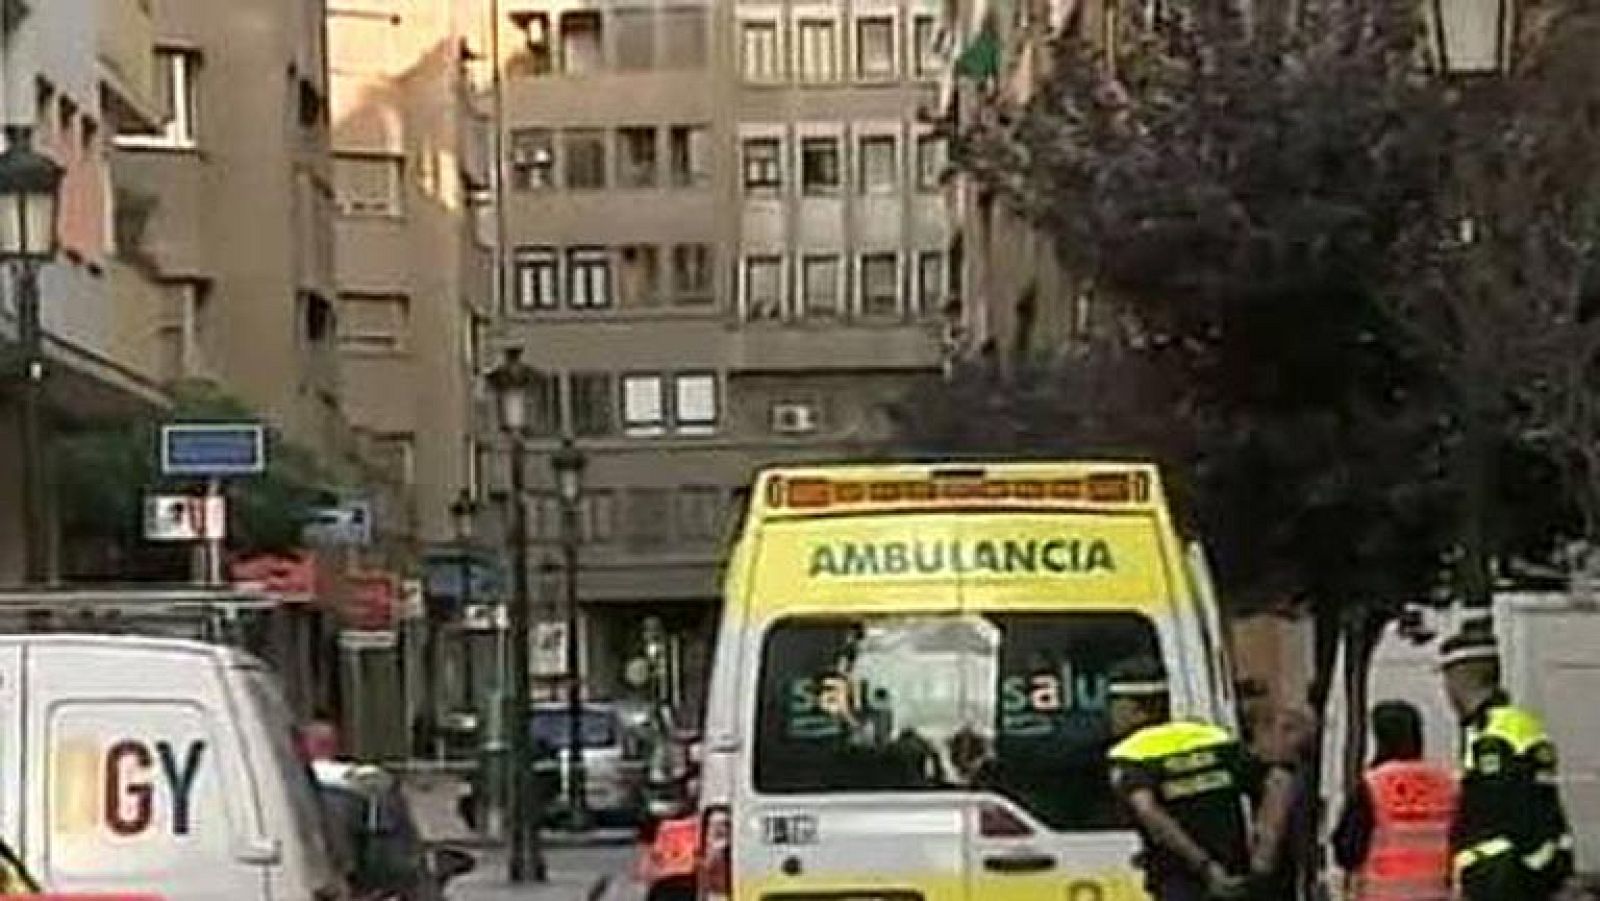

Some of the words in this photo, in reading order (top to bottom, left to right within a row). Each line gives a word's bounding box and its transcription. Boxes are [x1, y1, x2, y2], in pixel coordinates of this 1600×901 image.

[808, 539, 1117, 577] AMBULANCIA
[1002, 660, 1109, 713] salu
[104, 738, 207, 838] GY
